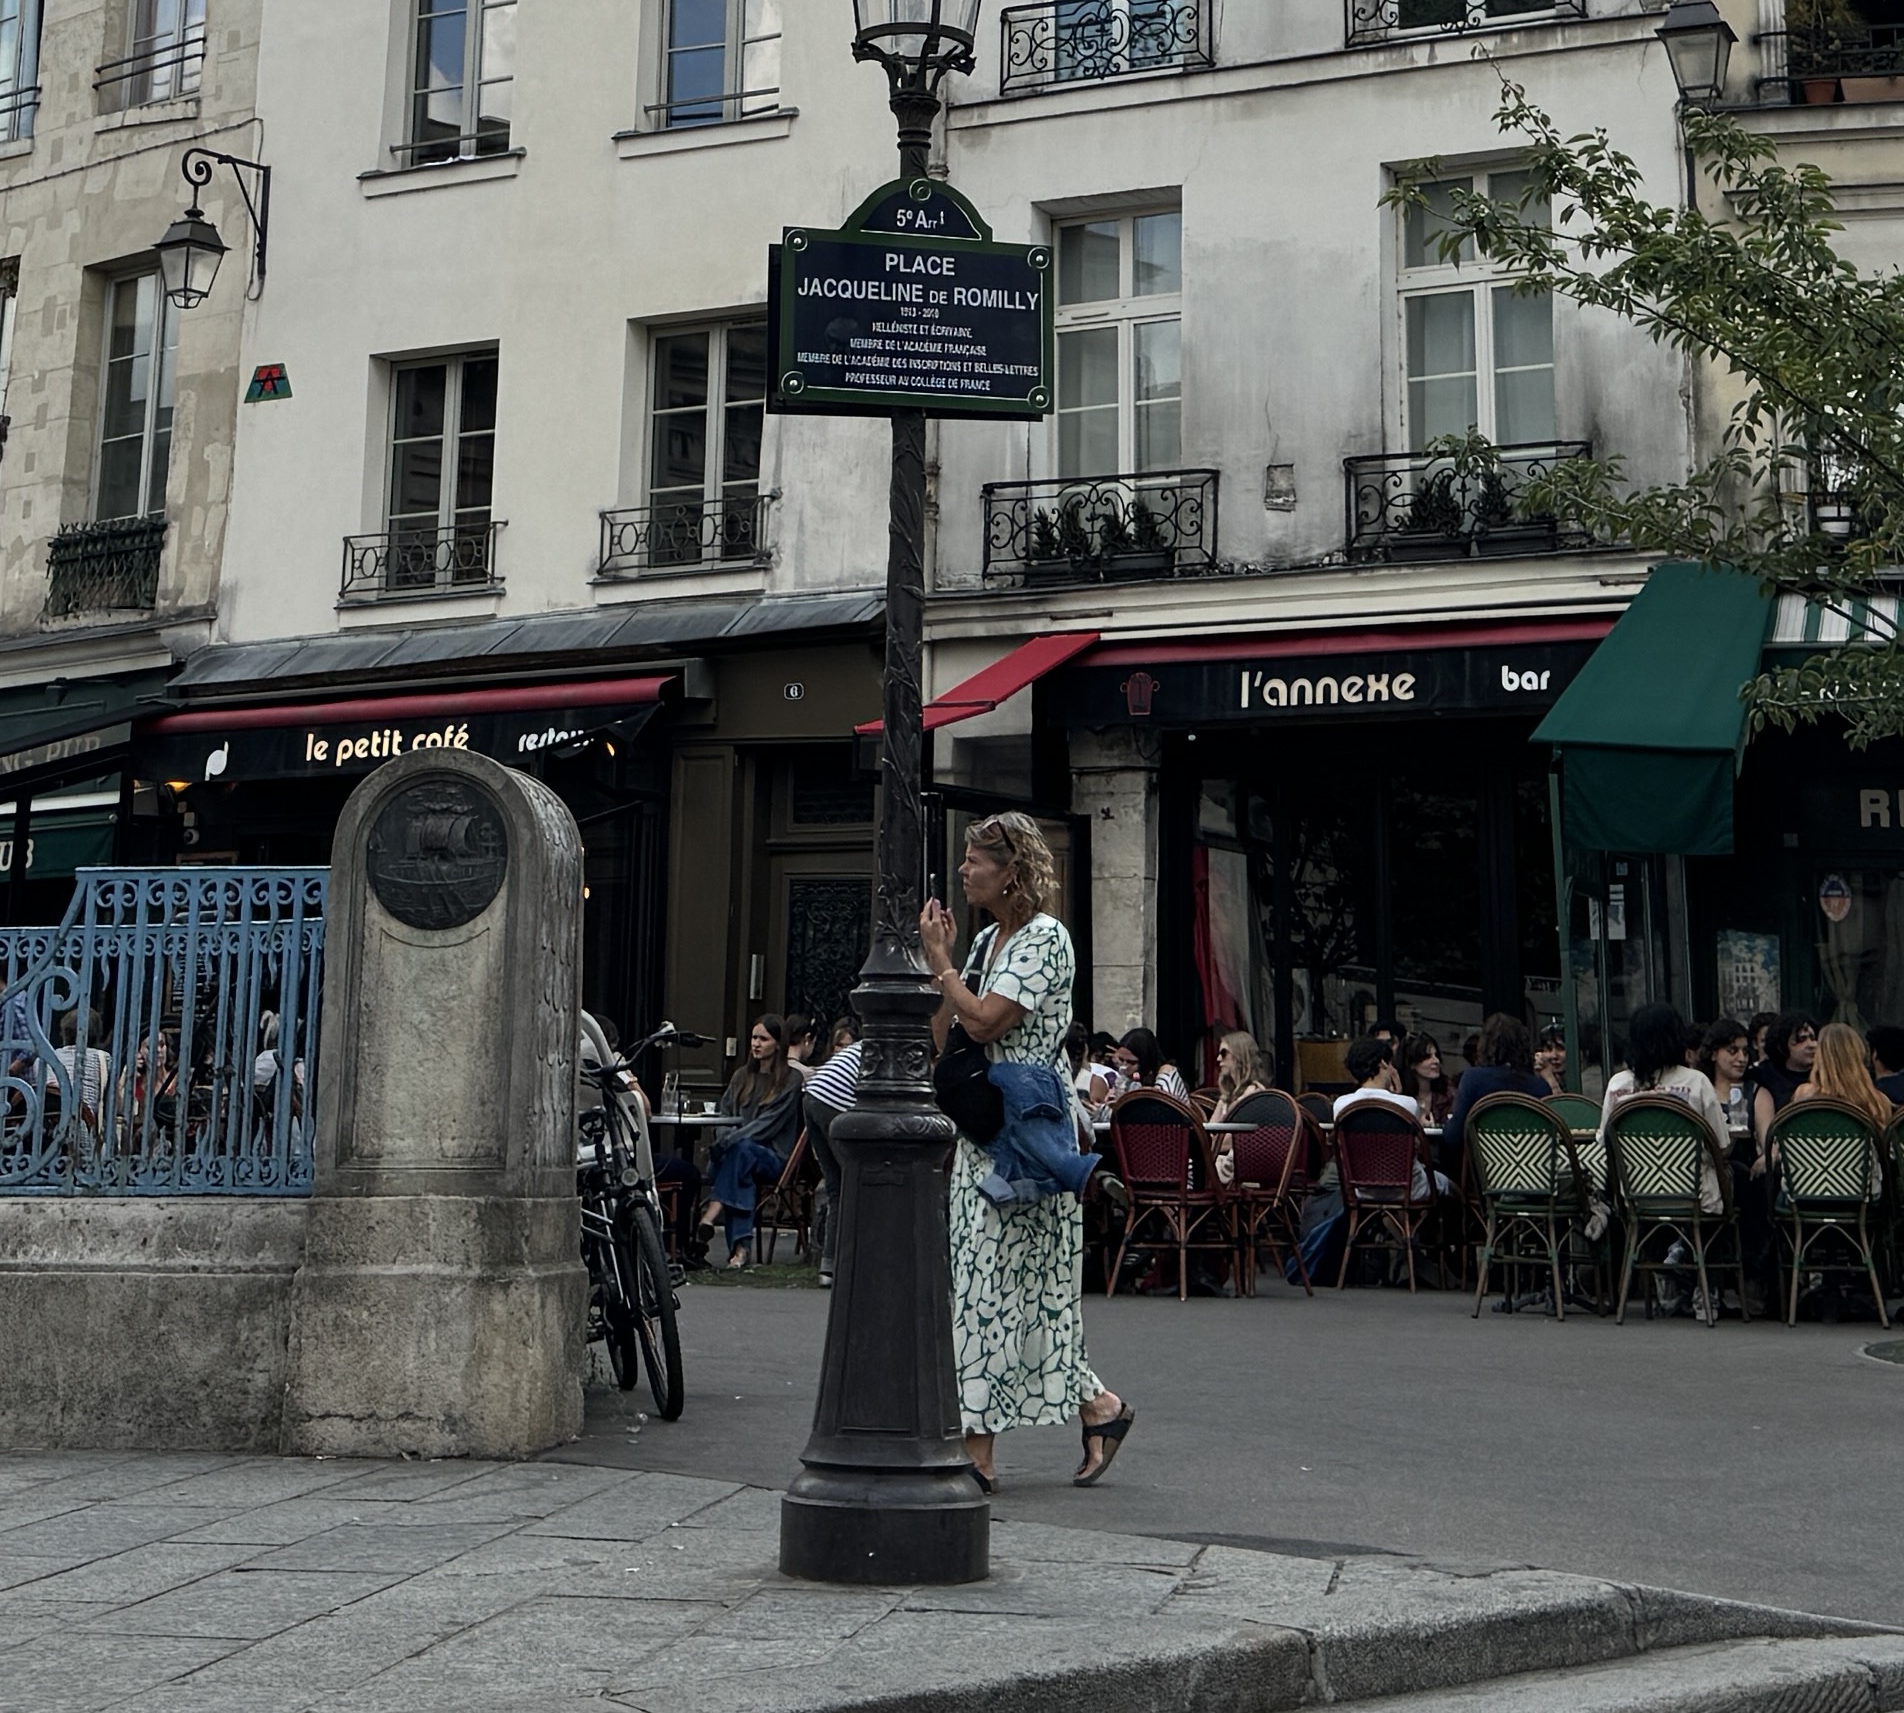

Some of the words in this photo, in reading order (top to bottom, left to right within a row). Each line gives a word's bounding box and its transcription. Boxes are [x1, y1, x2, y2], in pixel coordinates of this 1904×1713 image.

[885, 253, 956, 276] PLACE
[797, 277, 924, 303] JACQUELINE
[929, 290, 949, 305] DE
[953, 286, 1039, 311] ROMILLY
[919, 323, 930, 336] ET
[849, 337, 884, 350] MEMBRE
[885, 339, 896, 351] DE
[896, 338, 943, 354] L'ACADÉMIE
[944, 343, 987, 357] FRANÇAISE
[797, 351, 831, 365] MEMBRE
[831, 353, 843, 365] DE
[844, 352, 891, 368] L'ACADÉMIE
[892, 356, 907, 369] DES
[908, 358, 962, 373] INSCRIPTIONS
[963, 362, 973, 373] ET
[845, 372, 897, 386] PROFESSEUR
[910, 373, 946, 389] COLLÈGE
[947, 378, 958, 389] DE
[960, 378, 991, 391] FRANCE
[1500, 663, 1552, 693] bar
[1239, 670, 1416, 710] l'annexe
[306, 731, 328, 763] le
[335, 729, 402, 767] petit
[411, 722, 470, 753] café
